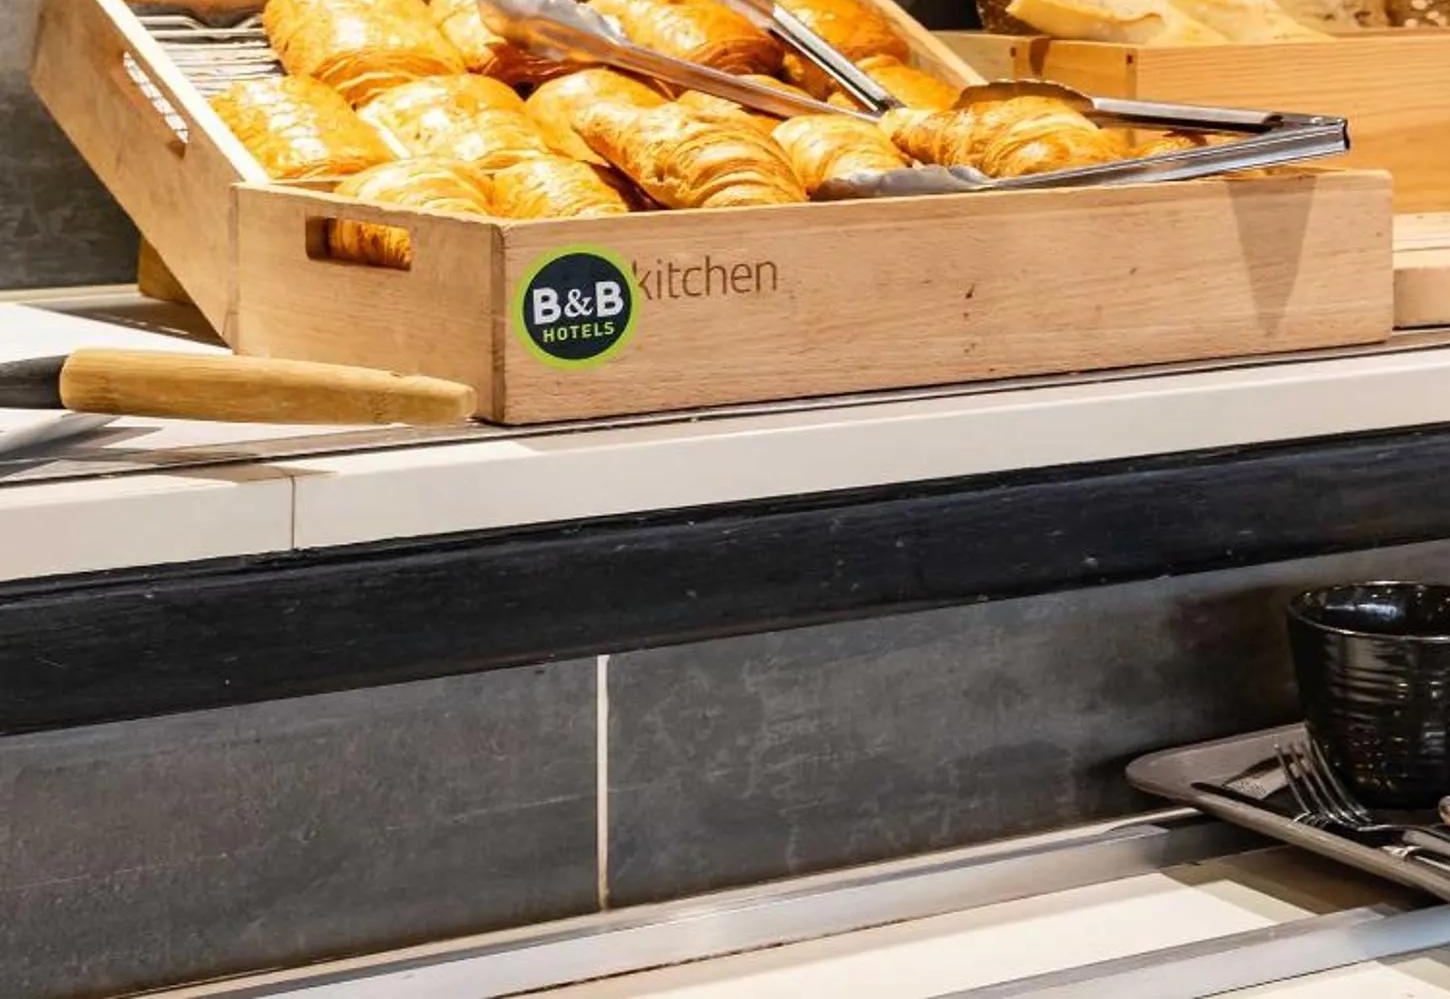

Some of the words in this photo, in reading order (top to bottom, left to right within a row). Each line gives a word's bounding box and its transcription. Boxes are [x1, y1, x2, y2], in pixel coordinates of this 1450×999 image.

[632, 255, 778, 301] kitchen
[532, 280, 625, 325] B&B
[542, 321, 616, 343] HOTELS
